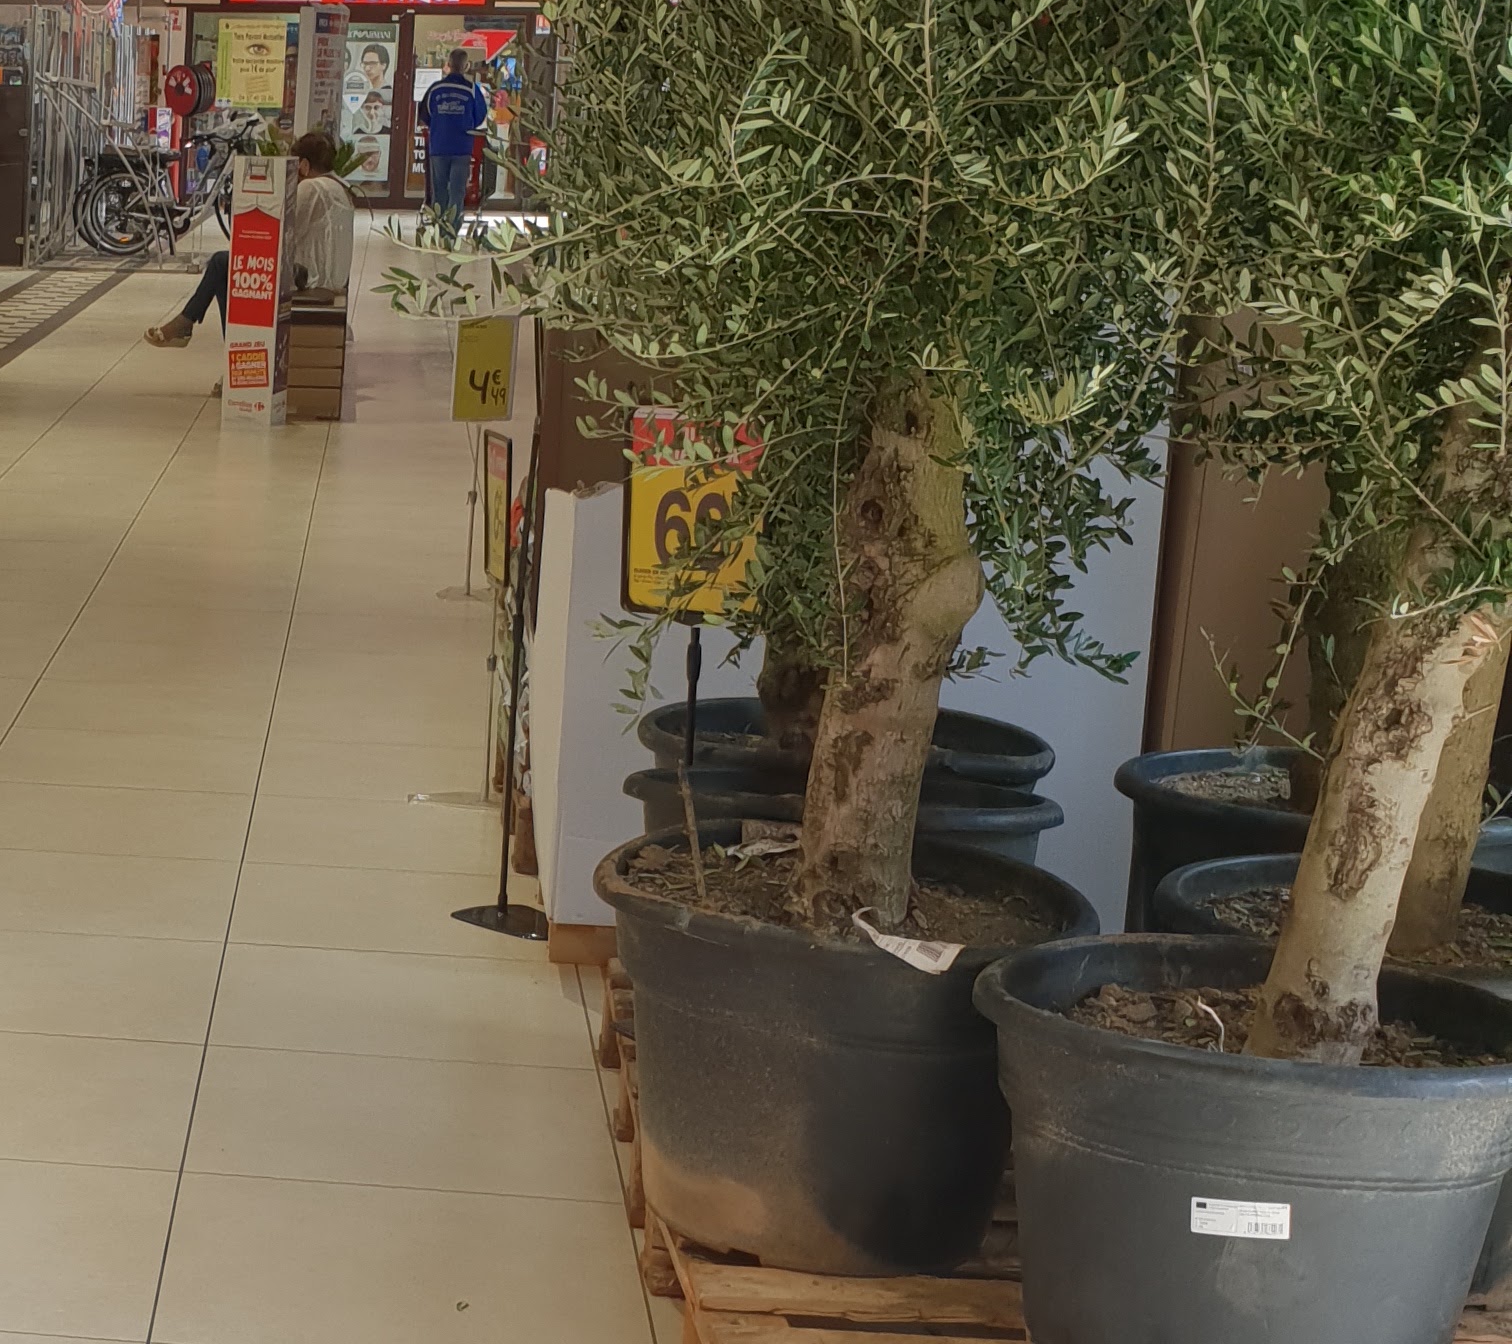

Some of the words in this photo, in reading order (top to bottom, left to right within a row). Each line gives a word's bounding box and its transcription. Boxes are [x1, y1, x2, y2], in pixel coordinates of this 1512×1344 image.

[233, 255, 244, 271] LE
[247, 255, 274, 272] MOIS
[233, 272, 273, 291] 100%
[232, 288, 272, 300] GAGNANT
